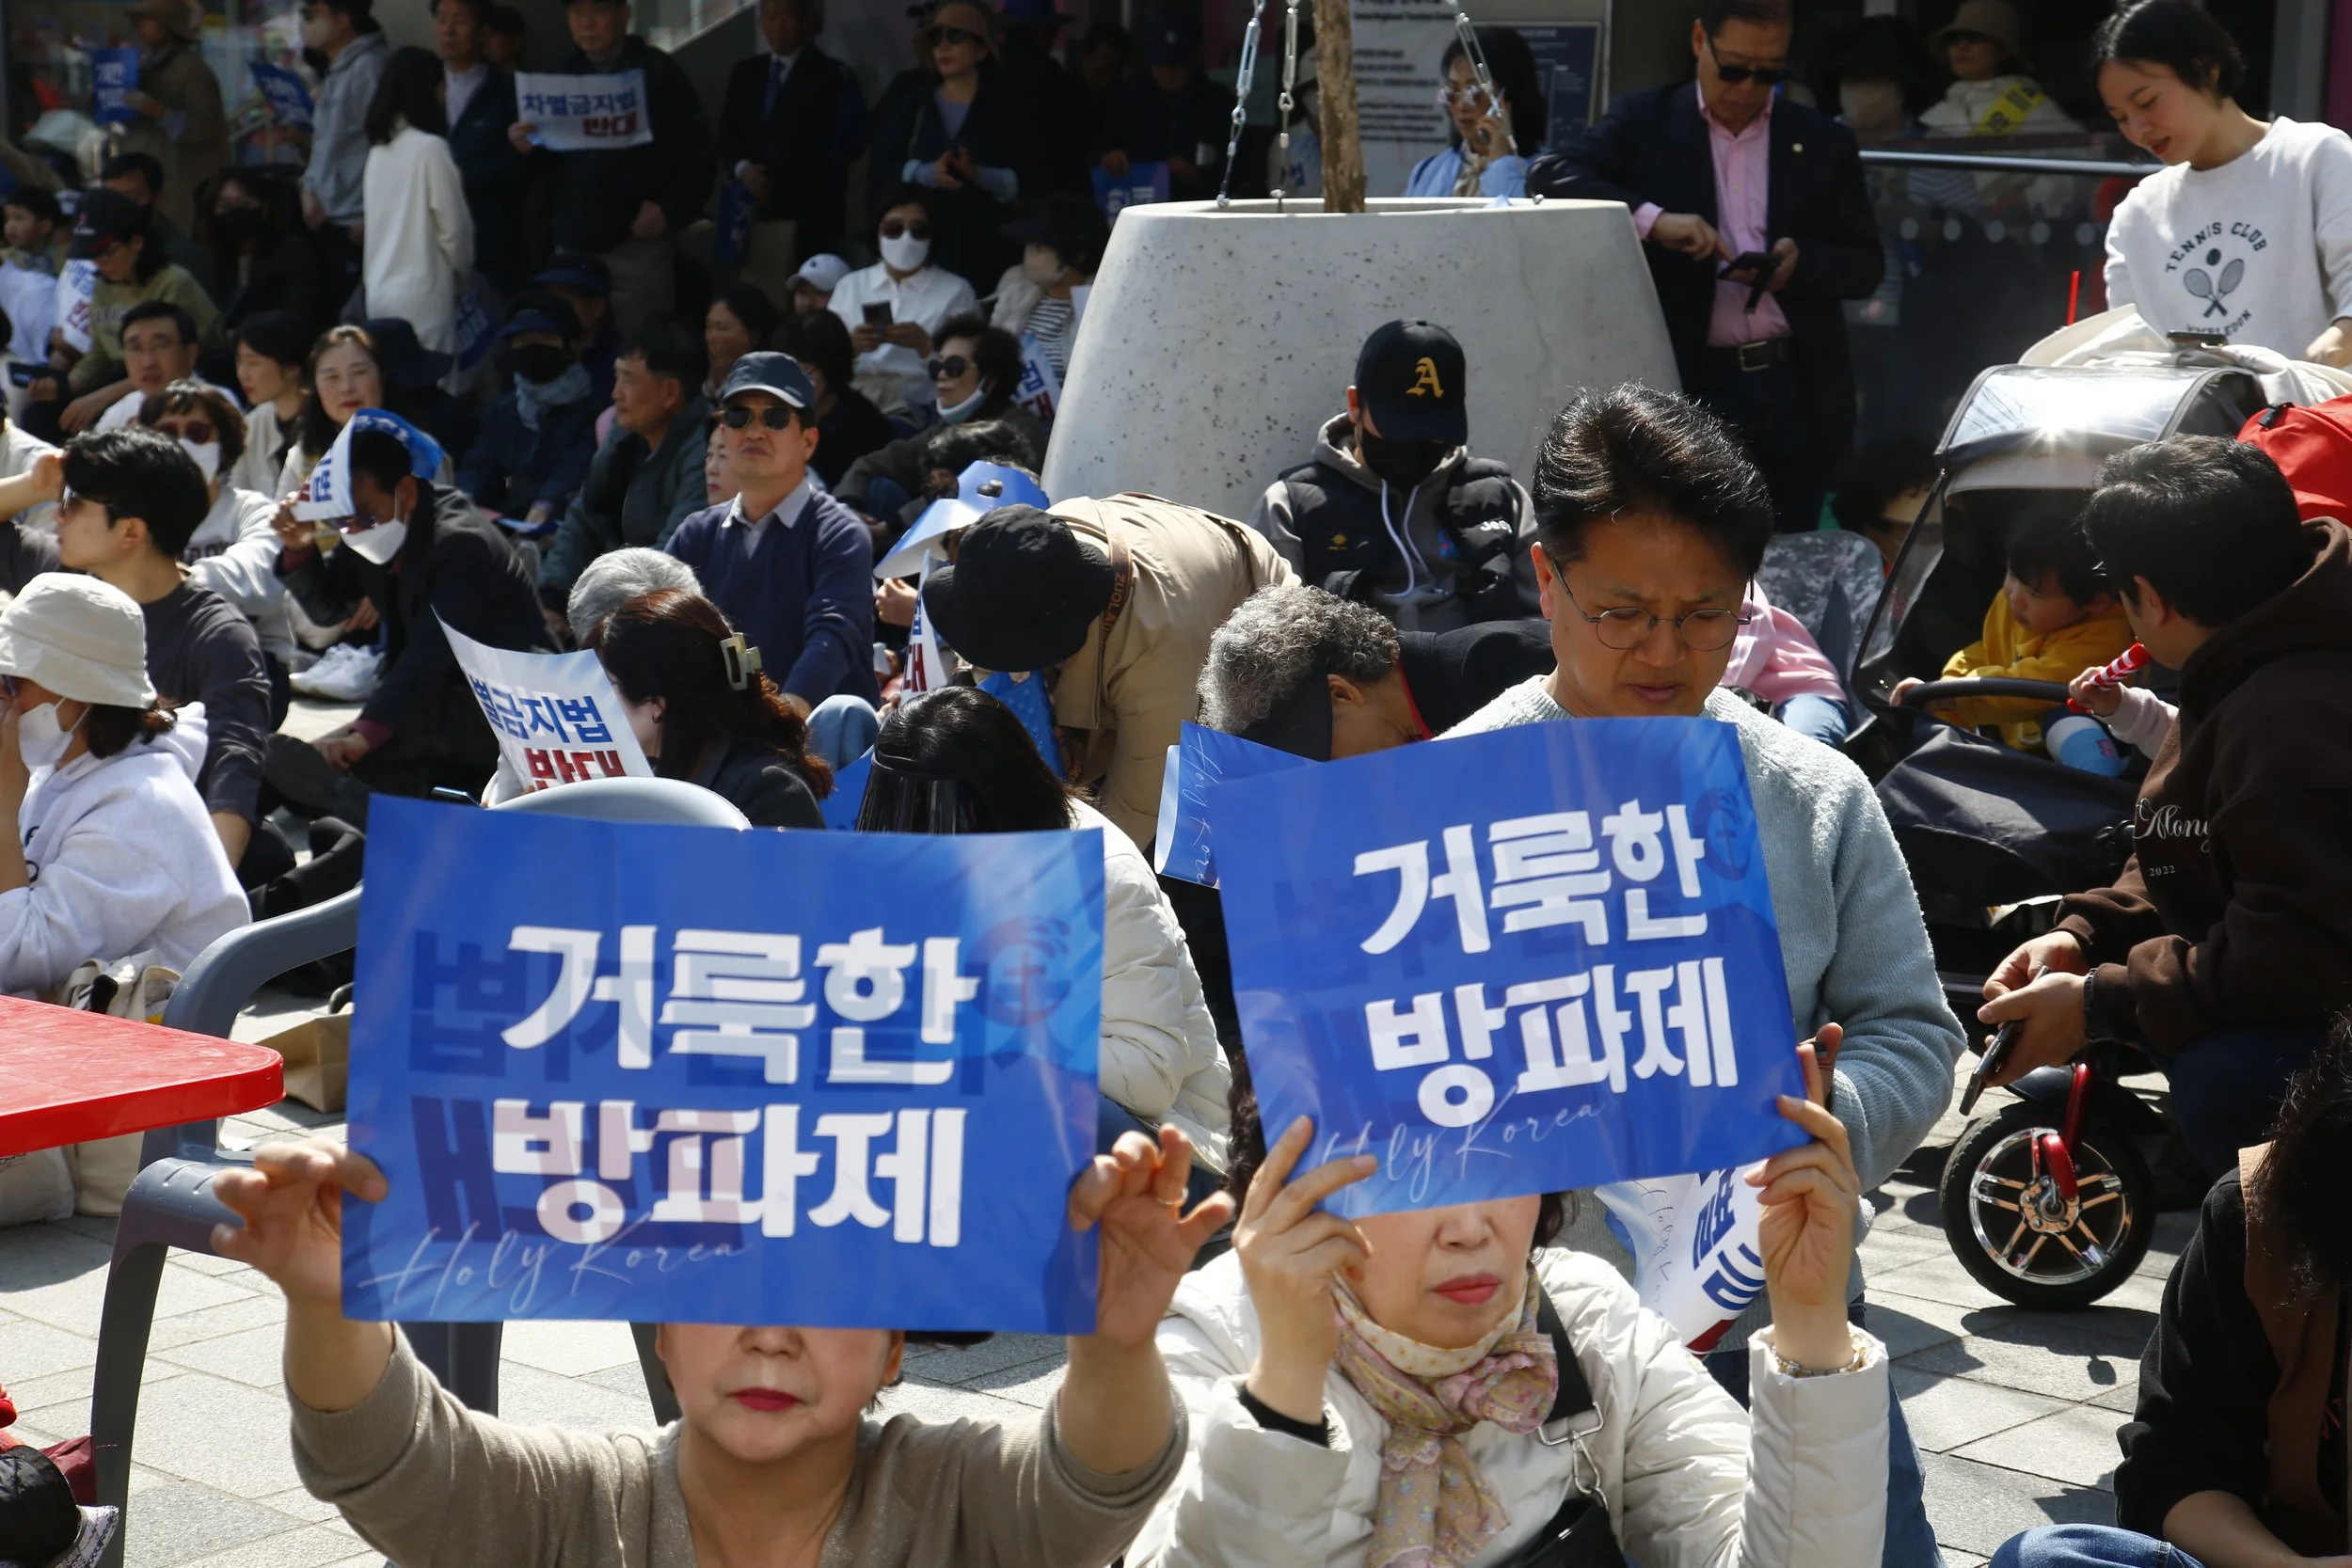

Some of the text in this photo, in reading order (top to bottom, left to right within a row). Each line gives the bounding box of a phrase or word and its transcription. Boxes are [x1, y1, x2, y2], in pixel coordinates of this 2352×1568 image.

[582, 112, 638, 137] 반대
[2166, 222, 2267, 273] TENNIS CLUB
[1406, 356, 1445, 399] A
[1352, 798, 1708, 956] 거룩한
[2149, 865, 2176, 877] 2022
[500, 925, 982, 1087] 거룩한
[1364, 956, 1740, 1129] 방파제
[492, 1098, 968, 1249] 방파제
[1317, 1084, 1606, 1215] Hly Korea
[357, 1211, 752, 1317] Holy Korea
